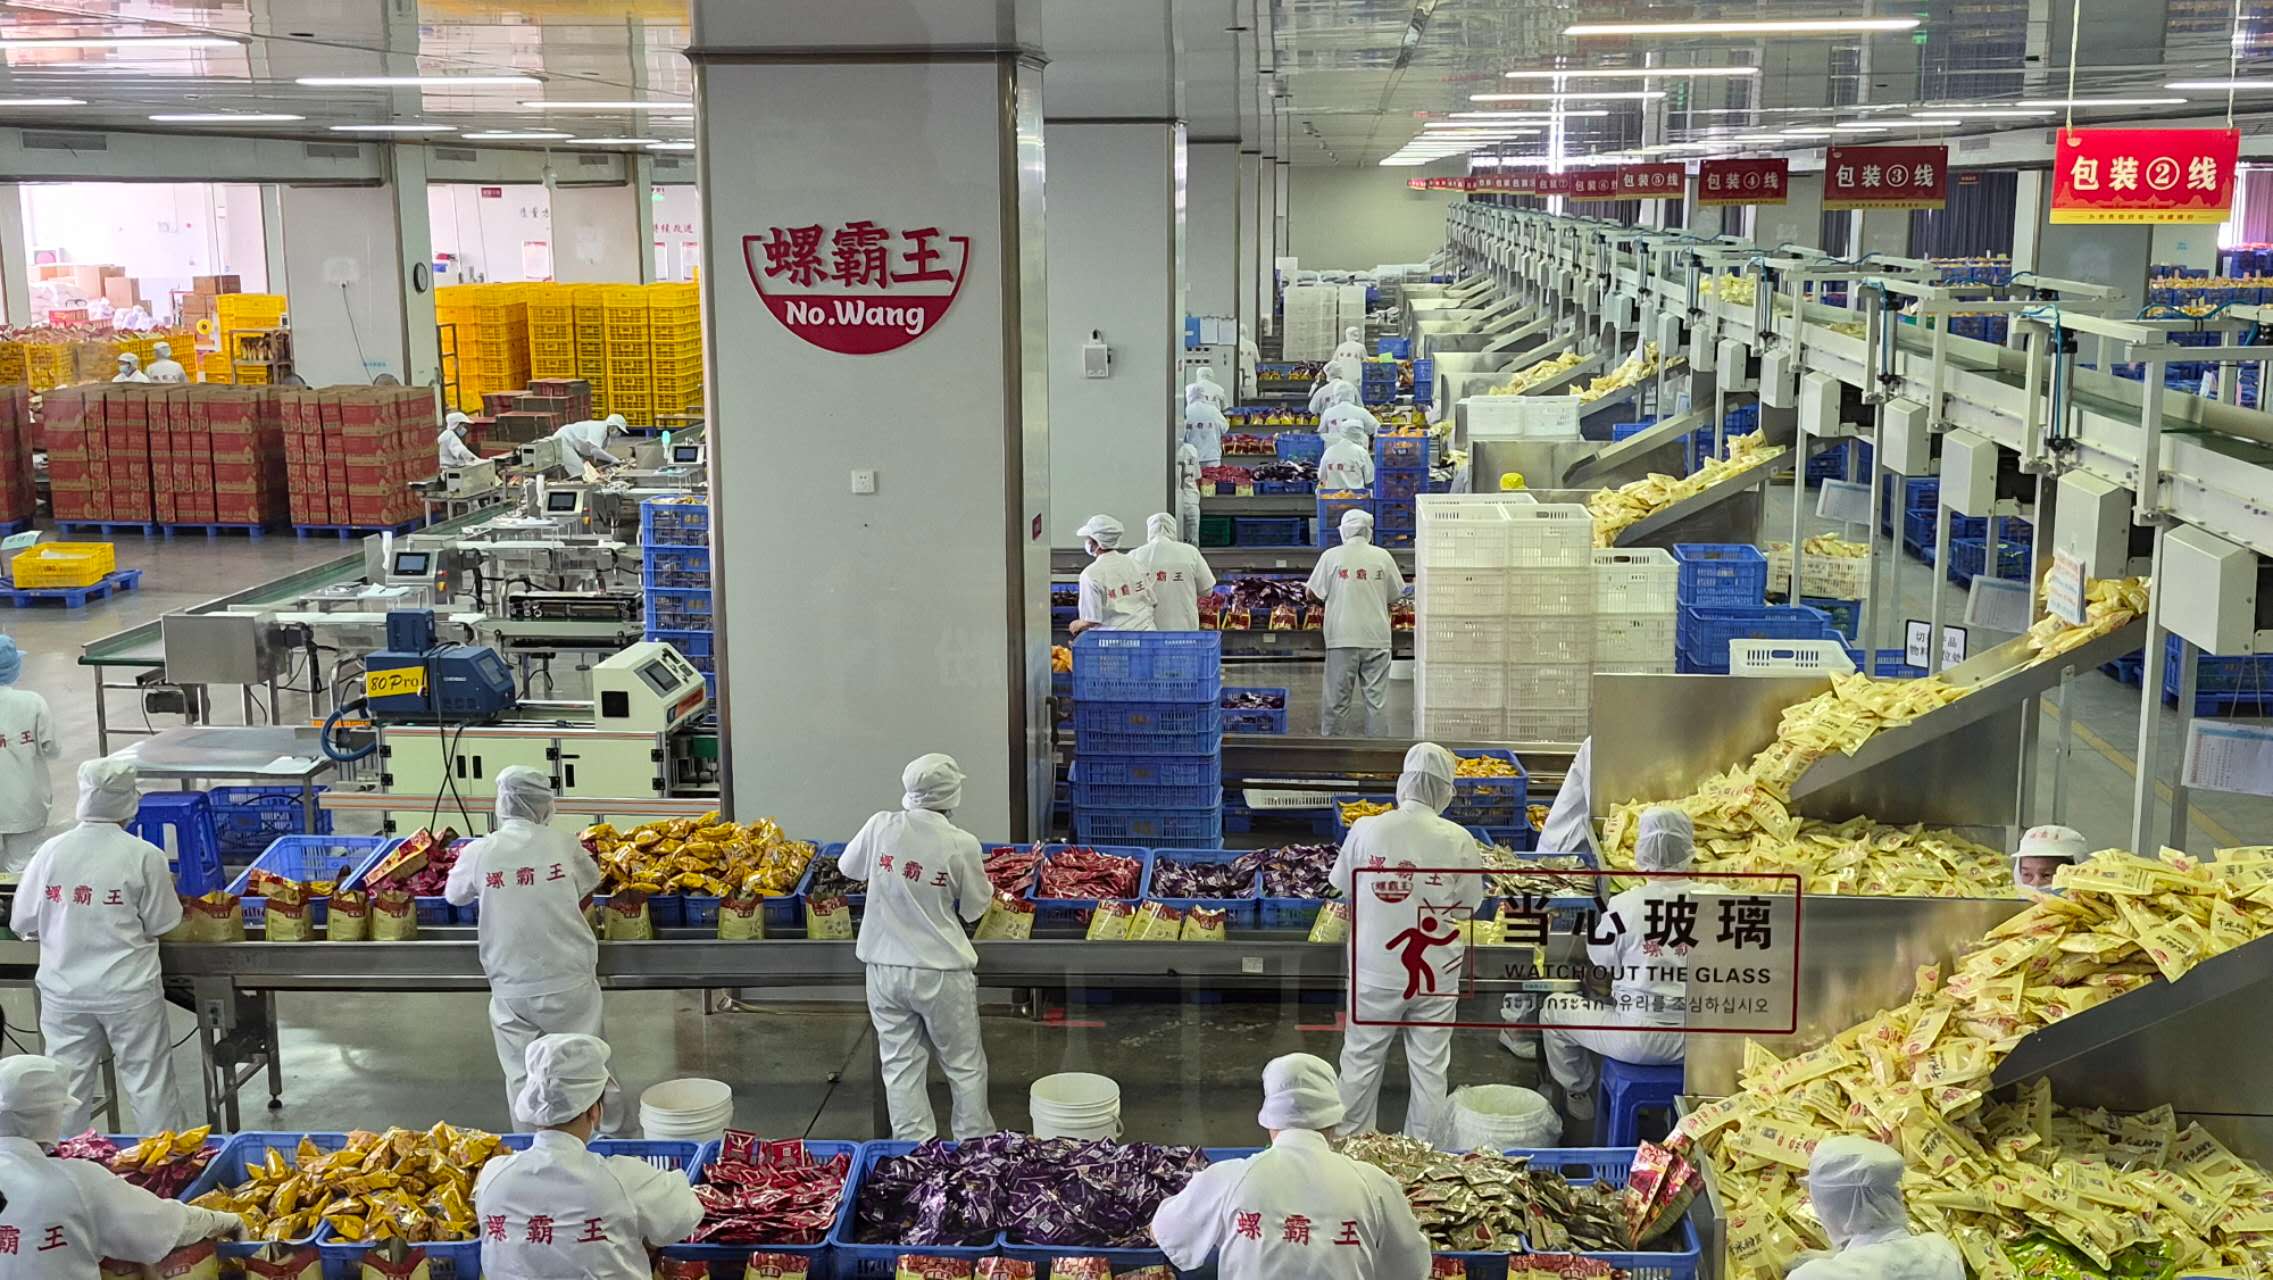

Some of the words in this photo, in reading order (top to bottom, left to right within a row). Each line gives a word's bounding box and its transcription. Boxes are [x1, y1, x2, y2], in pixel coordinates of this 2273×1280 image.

[1835, 163, 1934, 189] 包装③线
[2070, 154, 2217, 191] 包装②线
[762, 220, 955, 289] 螺霸王
[784, 300, 925, 336] No.Wang
[486, 862, 567, 889] 螺霸王
[880, 851, 949, 888] 螺霸王
[45, 884, 124, 906] 螺霸王
[1504, 892, 1772, 950] 当心玻璃
[1504, 963, 1585, 980] WATCH
[1593, 965, 1643, 982] OUT
[1646, 966, 1688, 983] THE
[1695, 966, 1771, 984] GLASS
[485, 1214, 609, 1244] 螺霸王
[1235, 1210, 1361, 1248] 螺霸王
